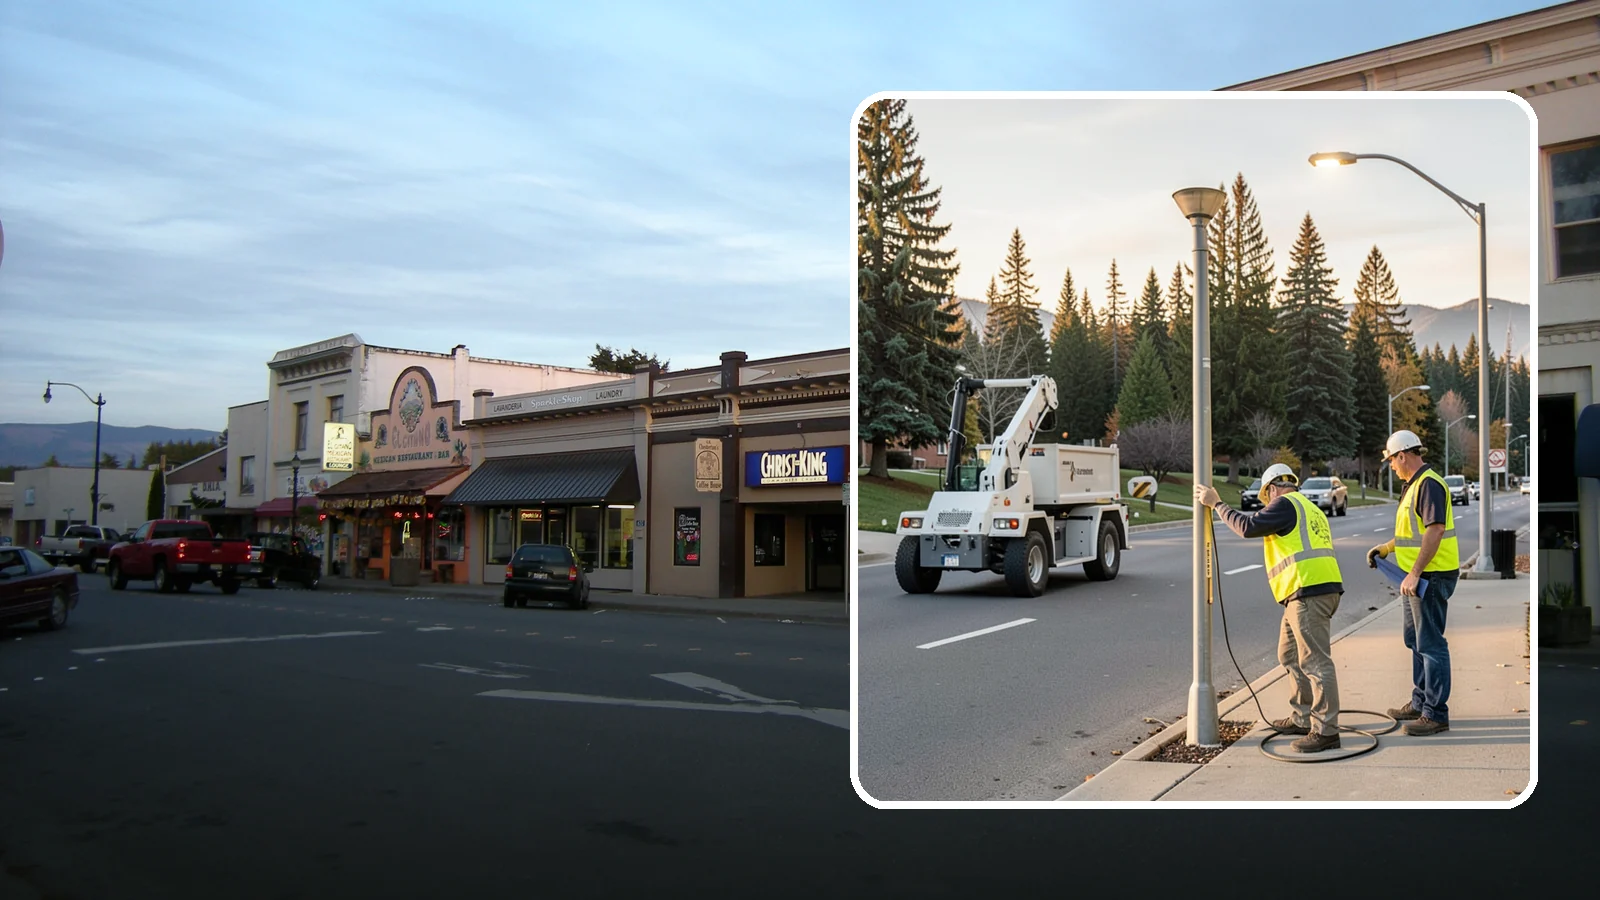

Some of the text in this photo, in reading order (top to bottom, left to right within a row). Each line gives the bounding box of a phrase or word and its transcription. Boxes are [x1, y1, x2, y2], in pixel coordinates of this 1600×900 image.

[595, 389, 624, 400] LAUNDRY
[493, 402, 523, 413] LAVANDERIA
[397, 451, 434, 463] RESTAURANT
[438, 450, 450, 459] BAR
[760, 449, 827, 478] CHRIST KING
